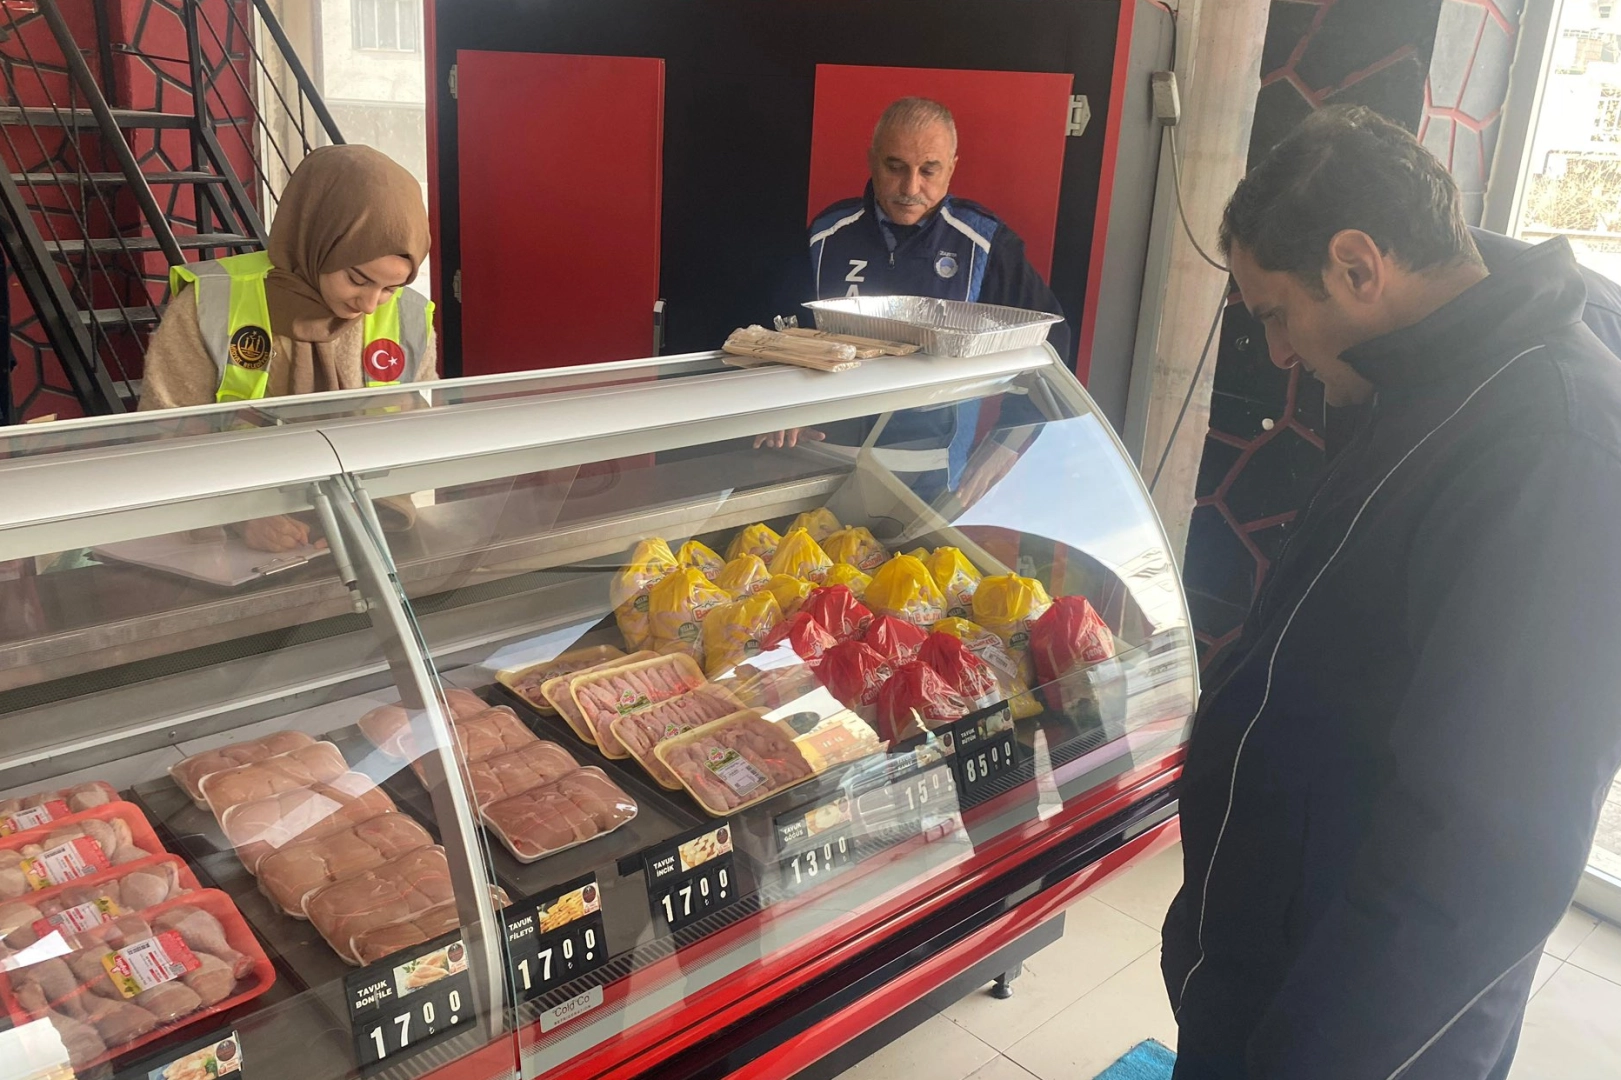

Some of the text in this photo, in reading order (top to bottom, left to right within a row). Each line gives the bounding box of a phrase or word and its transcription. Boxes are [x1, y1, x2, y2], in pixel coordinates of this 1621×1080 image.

[960, 728, 976, 738] TAVUK
[783, 822, 802, 834] TAVUK
[653, 855, 675, 870] TAVUK
[656, 864, 675, 877] İNCİK
[508, 915, 533, 931] TAVUK
[509, 926, 534, 942] FİLETO
[357, 979, 388, 998] TAVUK
[355, 988, 393, 1009] BONFİLE
